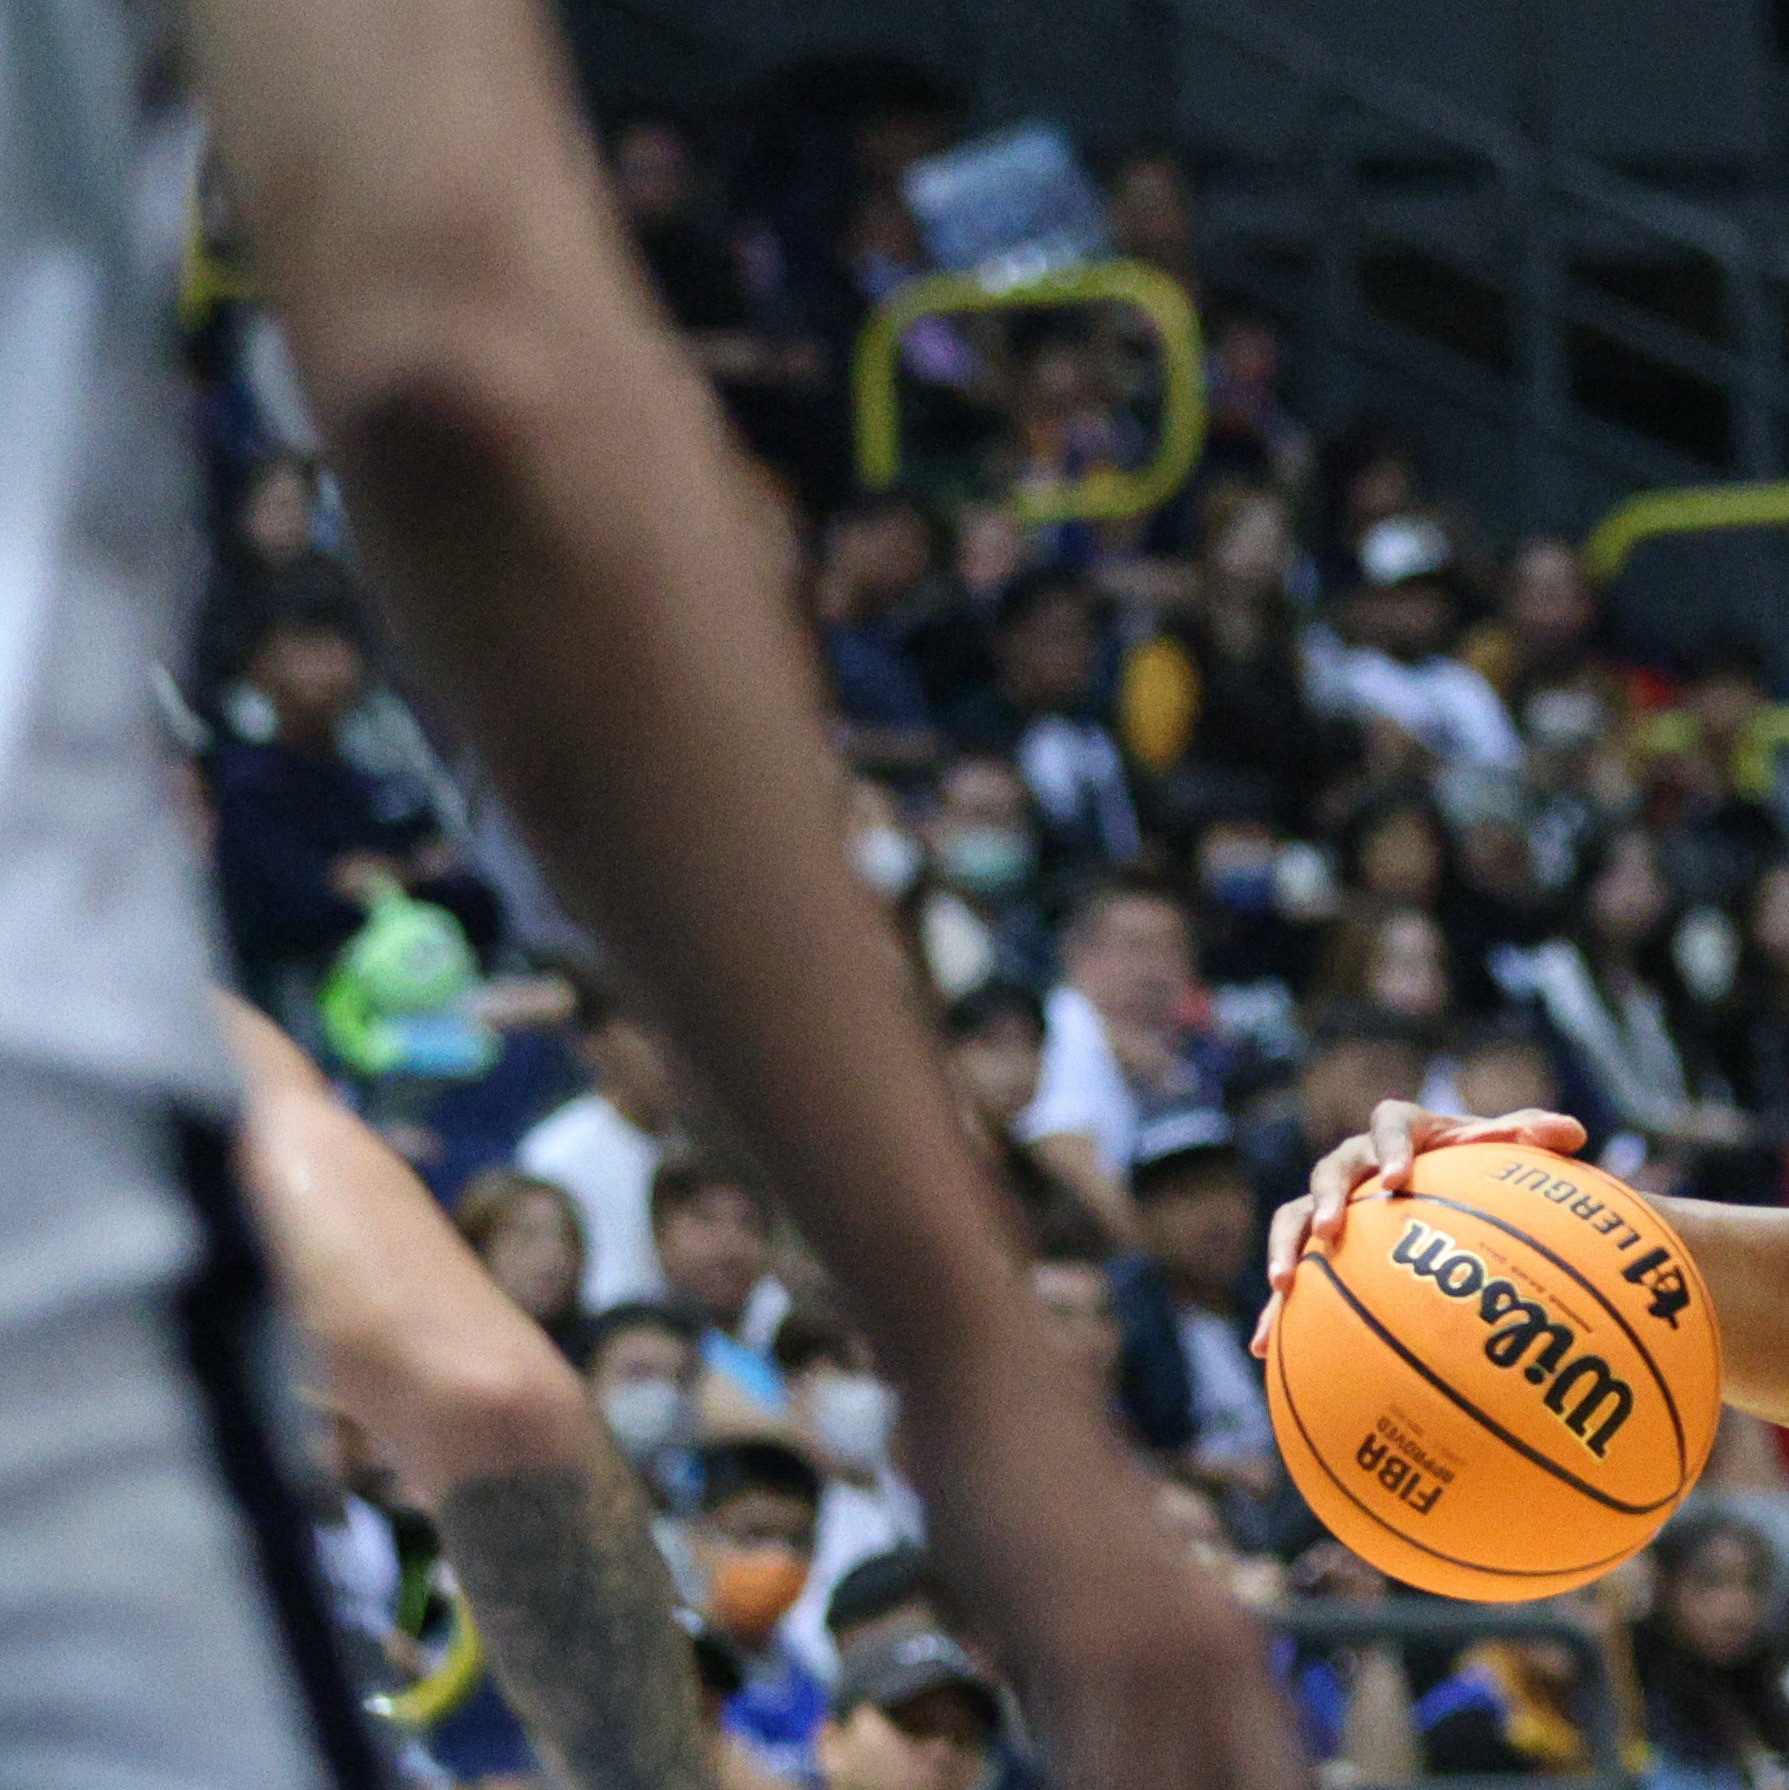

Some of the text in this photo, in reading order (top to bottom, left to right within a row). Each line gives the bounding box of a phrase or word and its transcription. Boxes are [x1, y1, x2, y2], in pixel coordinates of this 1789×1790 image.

[1491, 1161, 1643, 1249] LEAGUE
[1390, 1222, 1637, 1461] Wilson
[1355, 1432, 1444, 1516] FIBA
